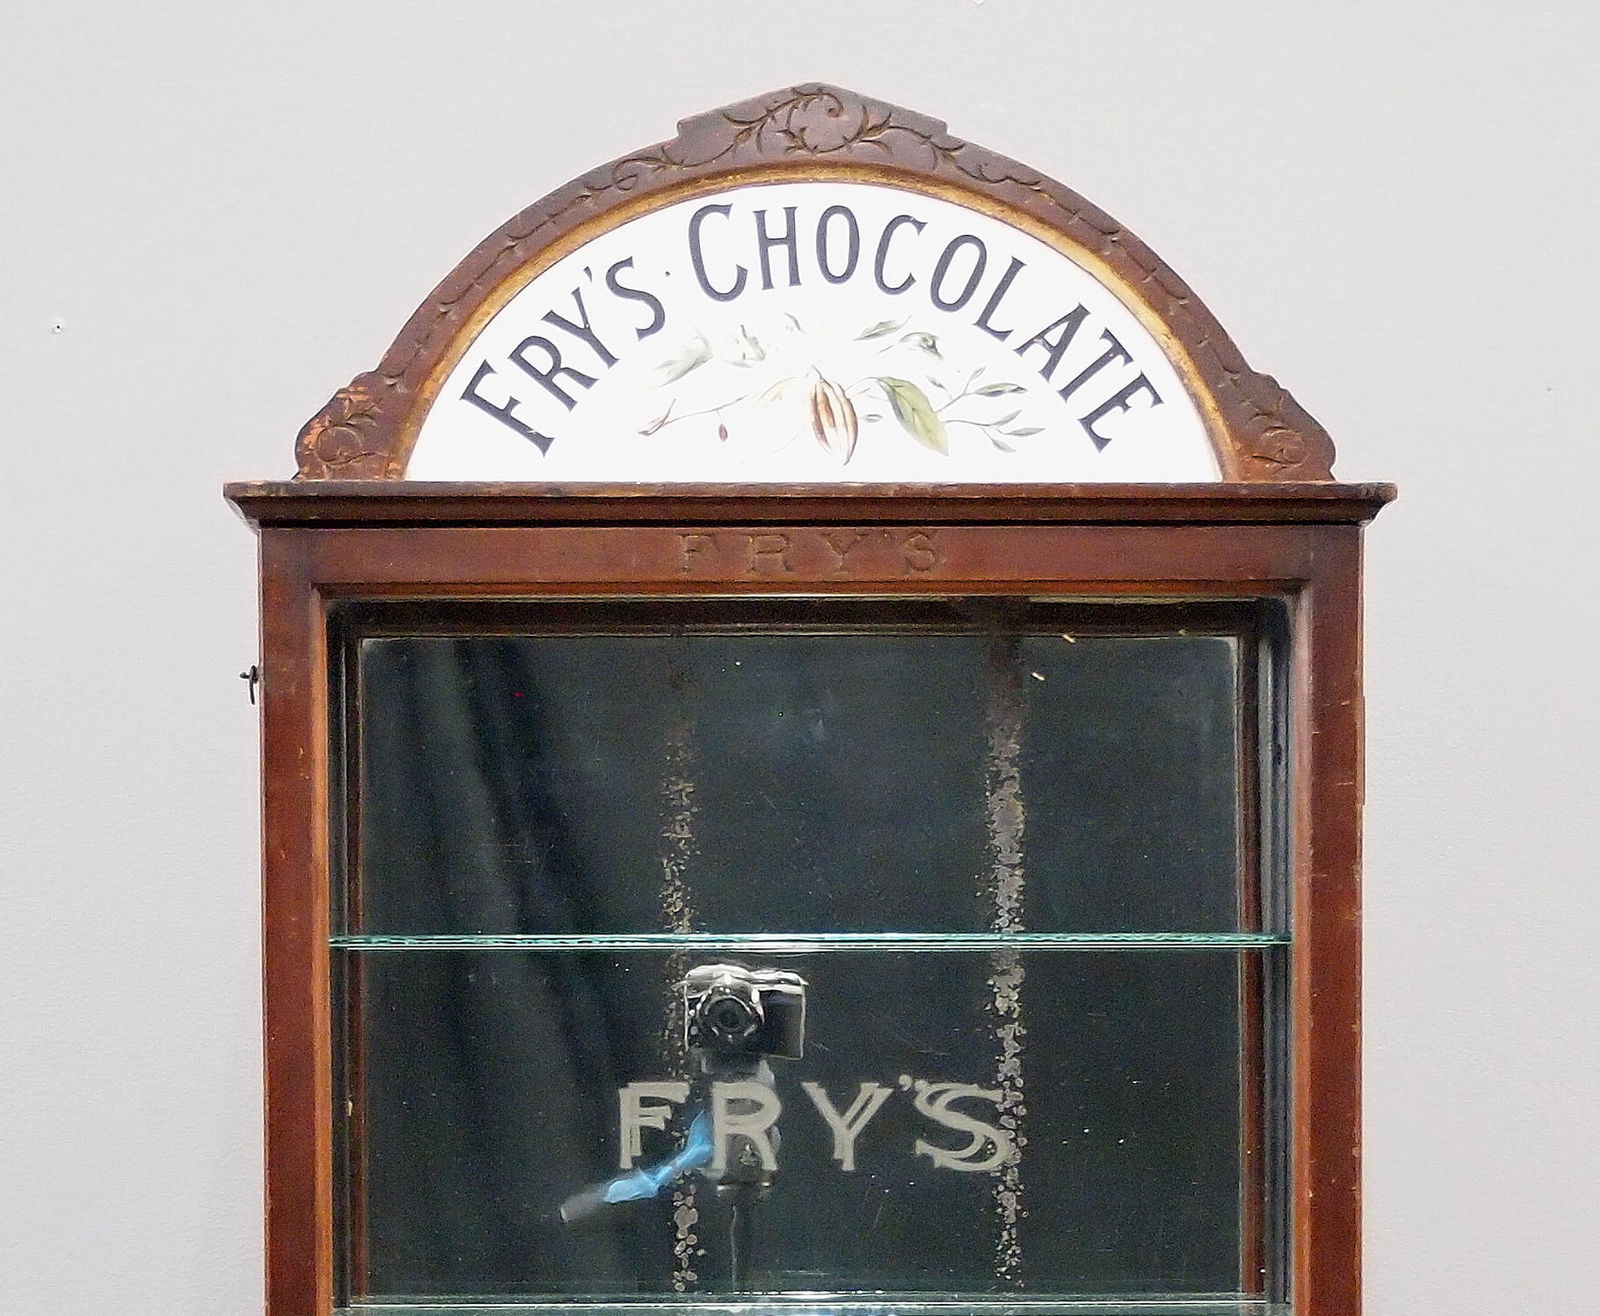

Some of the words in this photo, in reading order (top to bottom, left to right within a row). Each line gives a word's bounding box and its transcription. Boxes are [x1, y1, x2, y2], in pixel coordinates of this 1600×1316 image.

[460, 256, 665, 458] FRY'S
[687, 203, 1164, 454] CHOCOLATE
[676, 529, 944, 575] FRY'S
[618, 1074, 1012, 1172] FRY'S
